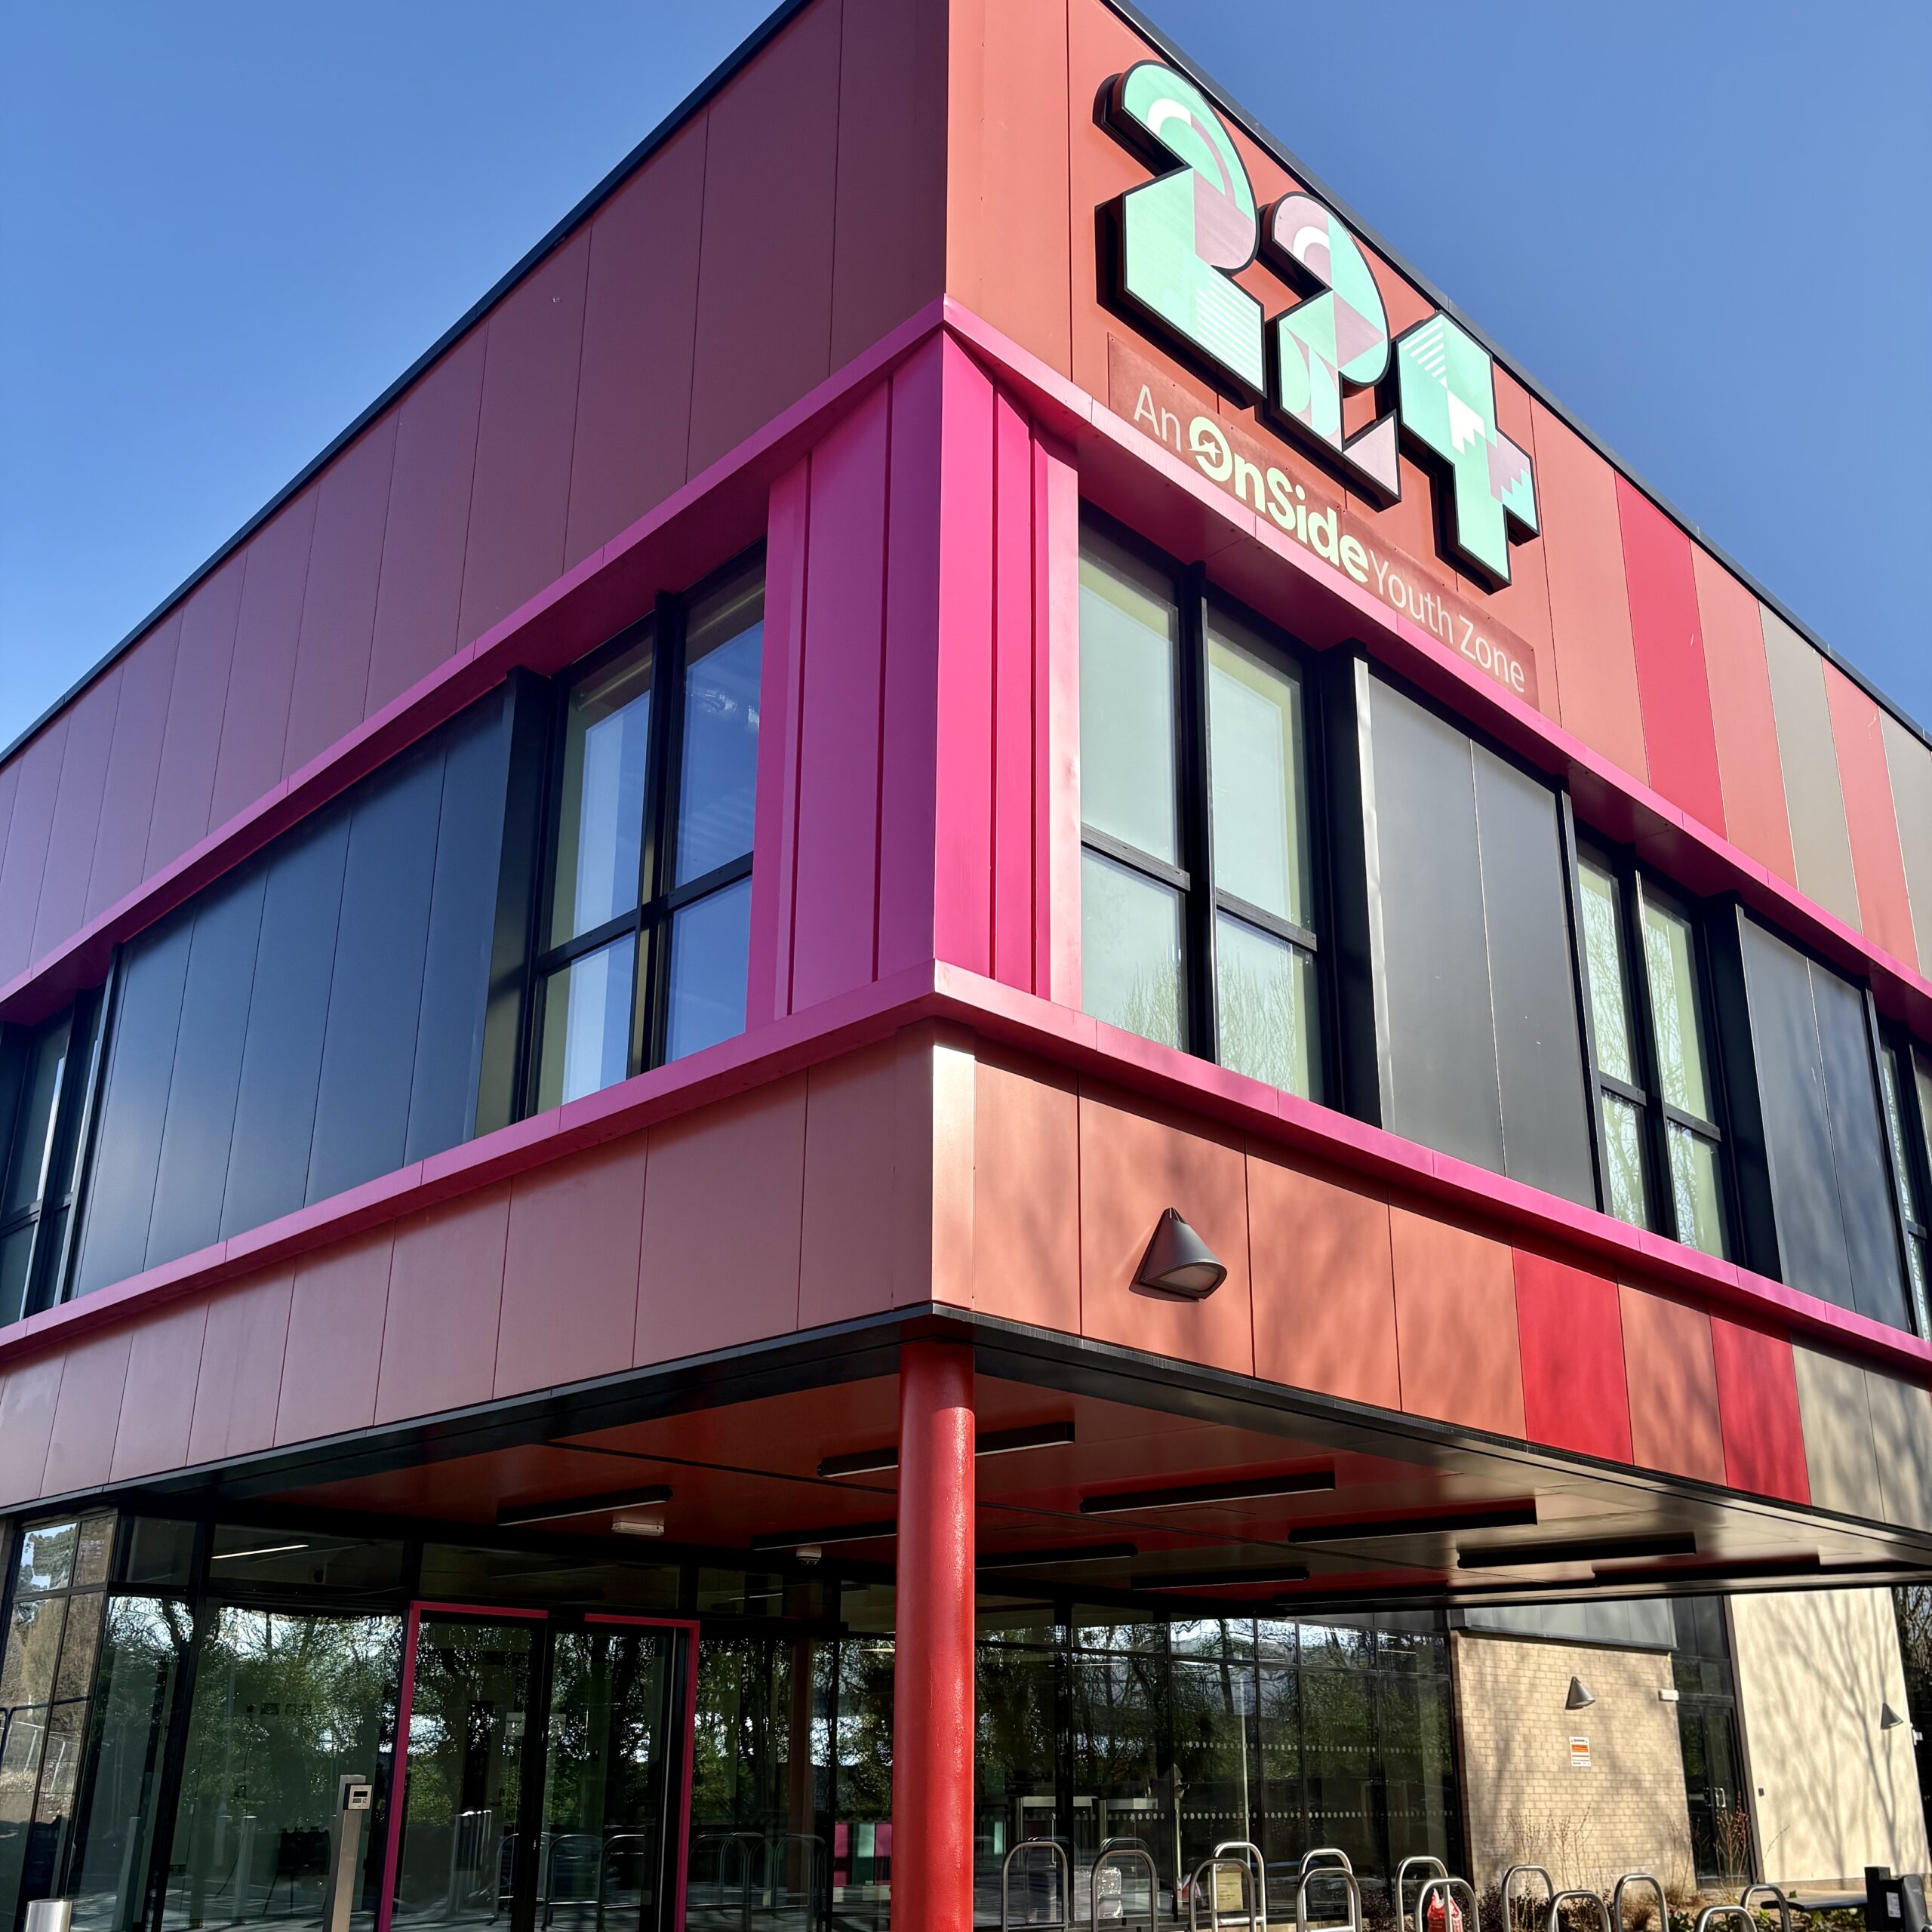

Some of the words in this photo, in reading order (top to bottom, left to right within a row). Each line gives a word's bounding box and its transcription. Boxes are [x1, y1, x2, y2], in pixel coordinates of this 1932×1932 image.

[1115, 60, 1540, 592] 224
[1134, 383, 1181, 453] An
[1189, 416, 1370, 583] OnSide
[1369, 549, 1454, 645] Youth
[1458, 614, 1525, 693] Zone
